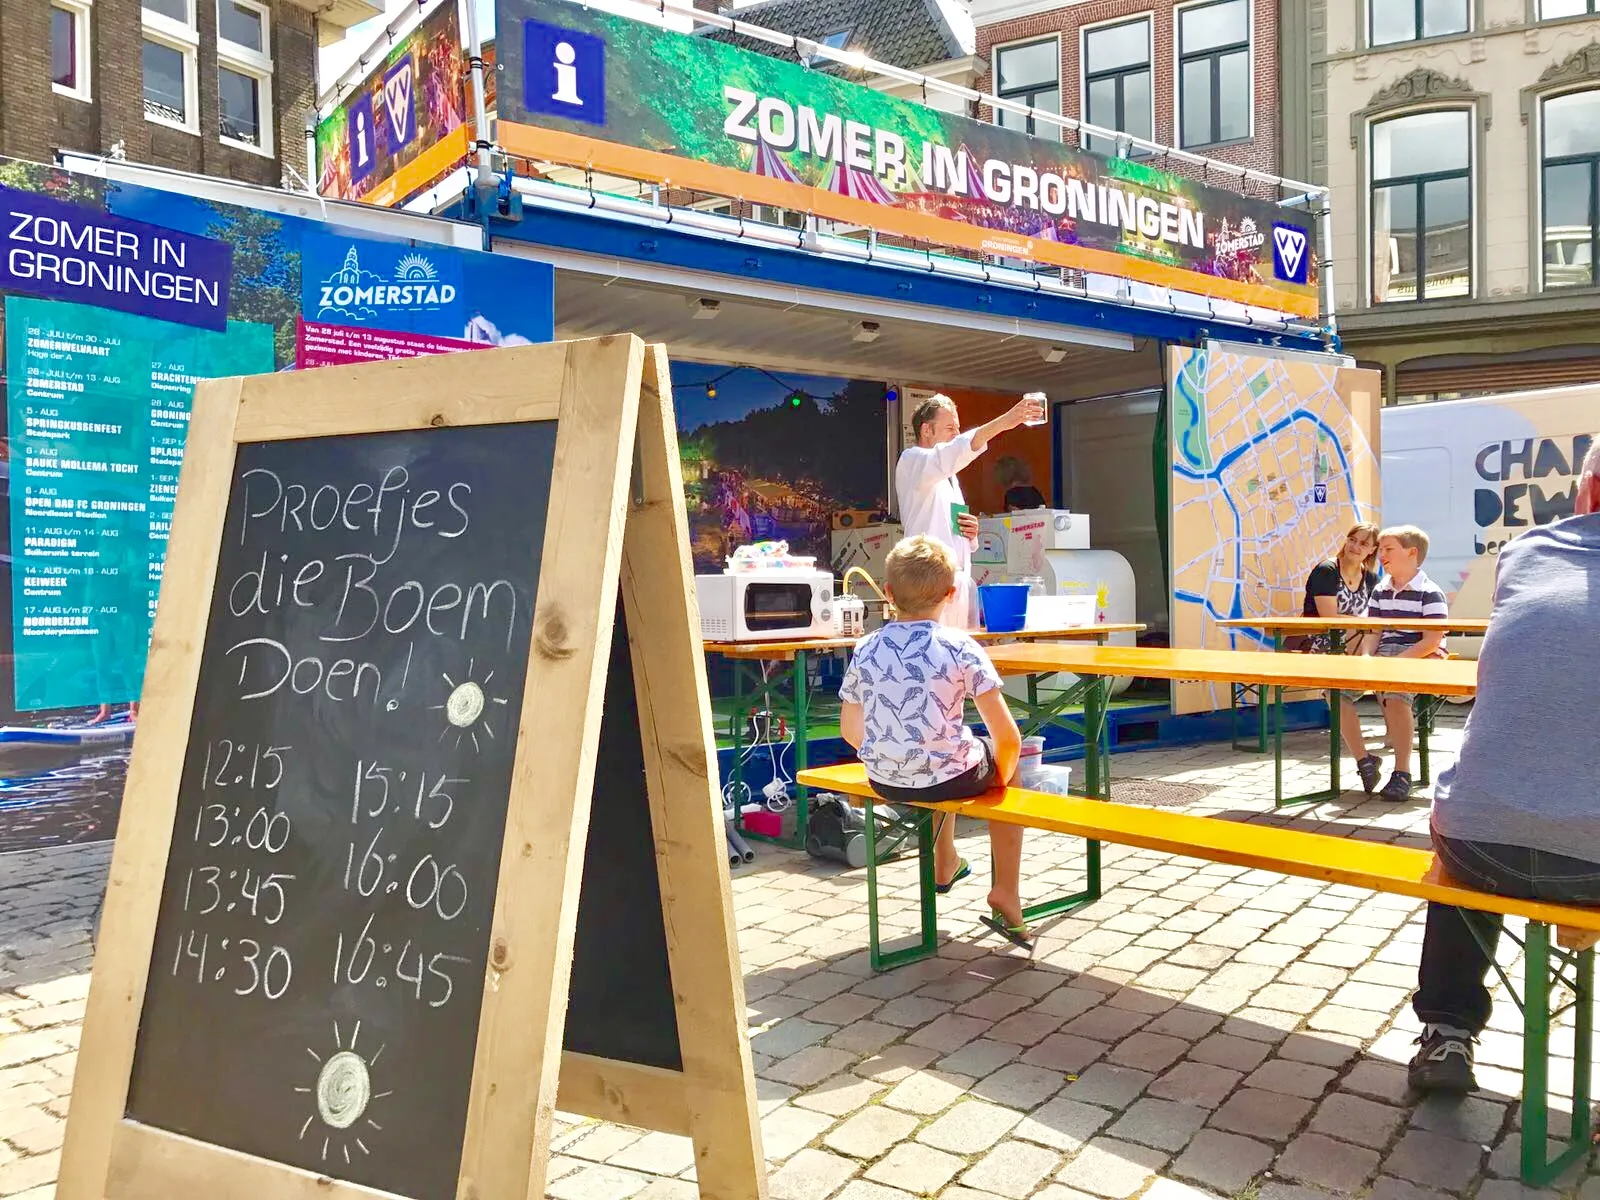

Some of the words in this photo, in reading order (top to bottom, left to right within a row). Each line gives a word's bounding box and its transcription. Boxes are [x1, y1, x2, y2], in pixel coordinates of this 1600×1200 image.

[725, 87, 907, 184] ZOMER
[922, 141, 969, 195] IN
[984, 160, 1204, 249] GRONINGEN
[9, 211, 139, 260] ZOMER
[154, 237, 186, 268] IN
[982, 240, 1028, 255] GRONINGEN
[1216, 233, 1264, 255] ZOMERSTAD
[9, 248, 219, 306] GRONINGEN
[319, 284, 456, 307] ZOMERSTAD
[305, 325, 319, 333] Van
[46, 330, 64, 338] JULI
[66, 333, 83, 342] t/m
[86, 334, 97, 343] 30
[104, 337, 121, 346] JULI
[28, 338, 110, 356] ZOMERWELVAART
[28, 350, 48, 360] Hoge
[46, 369, 64, 378] JULI
[66, 371, 83, 380] t/m
[86, 374, 96, 382] 13
[103, 376, 120, 384] AUG
[27, 377, 84, 393] ZOMERSTAD
[26, 389, 64, 399] Centrum
[40, 408, 58, 416] AUG
[26, 417, 122, 435] SPRINGKUSSENFEST
[151, 420, 184, 429] Centrum
[40, 448, 58, 456] AUG
[26, 458, 57, 469] BAUKE
[60, 460, 107, 472] MOLLEMA
[110, 463, 138, 474] TOCHT
[26, 469, 64, 478] Centrum
[25, 497, 51, 508] OPEN
[77, 500, 88, 510] FC
[91, 500, 146, 512] GRONINGEN
[64, 528, 81, 536] t/m
[24, 537, 77, 547] PARADIGM
[63, 567, 80, 575] t/m
[24, 577, 67, 587] KEIWEEK
[24, 588, 61, 596] Centrum
[43, 606, 61, 614] AUG
[82, 606, 94, 614] 27
[230, 551, 324, 616] die
[320, 552, 516, 653] Boem
[24, 617, 88, 626] NOORDERZON
[202, 740, 292, 790] 12:15
[352, 760, 470, 829] 15:15
[194, 804, 290, 853] 13:00
[344, 827, 468, 920] 16:00
[184, 866, 296, 924] 13:45
[172, 930, 292, 999] 14:30
[334, 913, 471, 1007] 16:45
